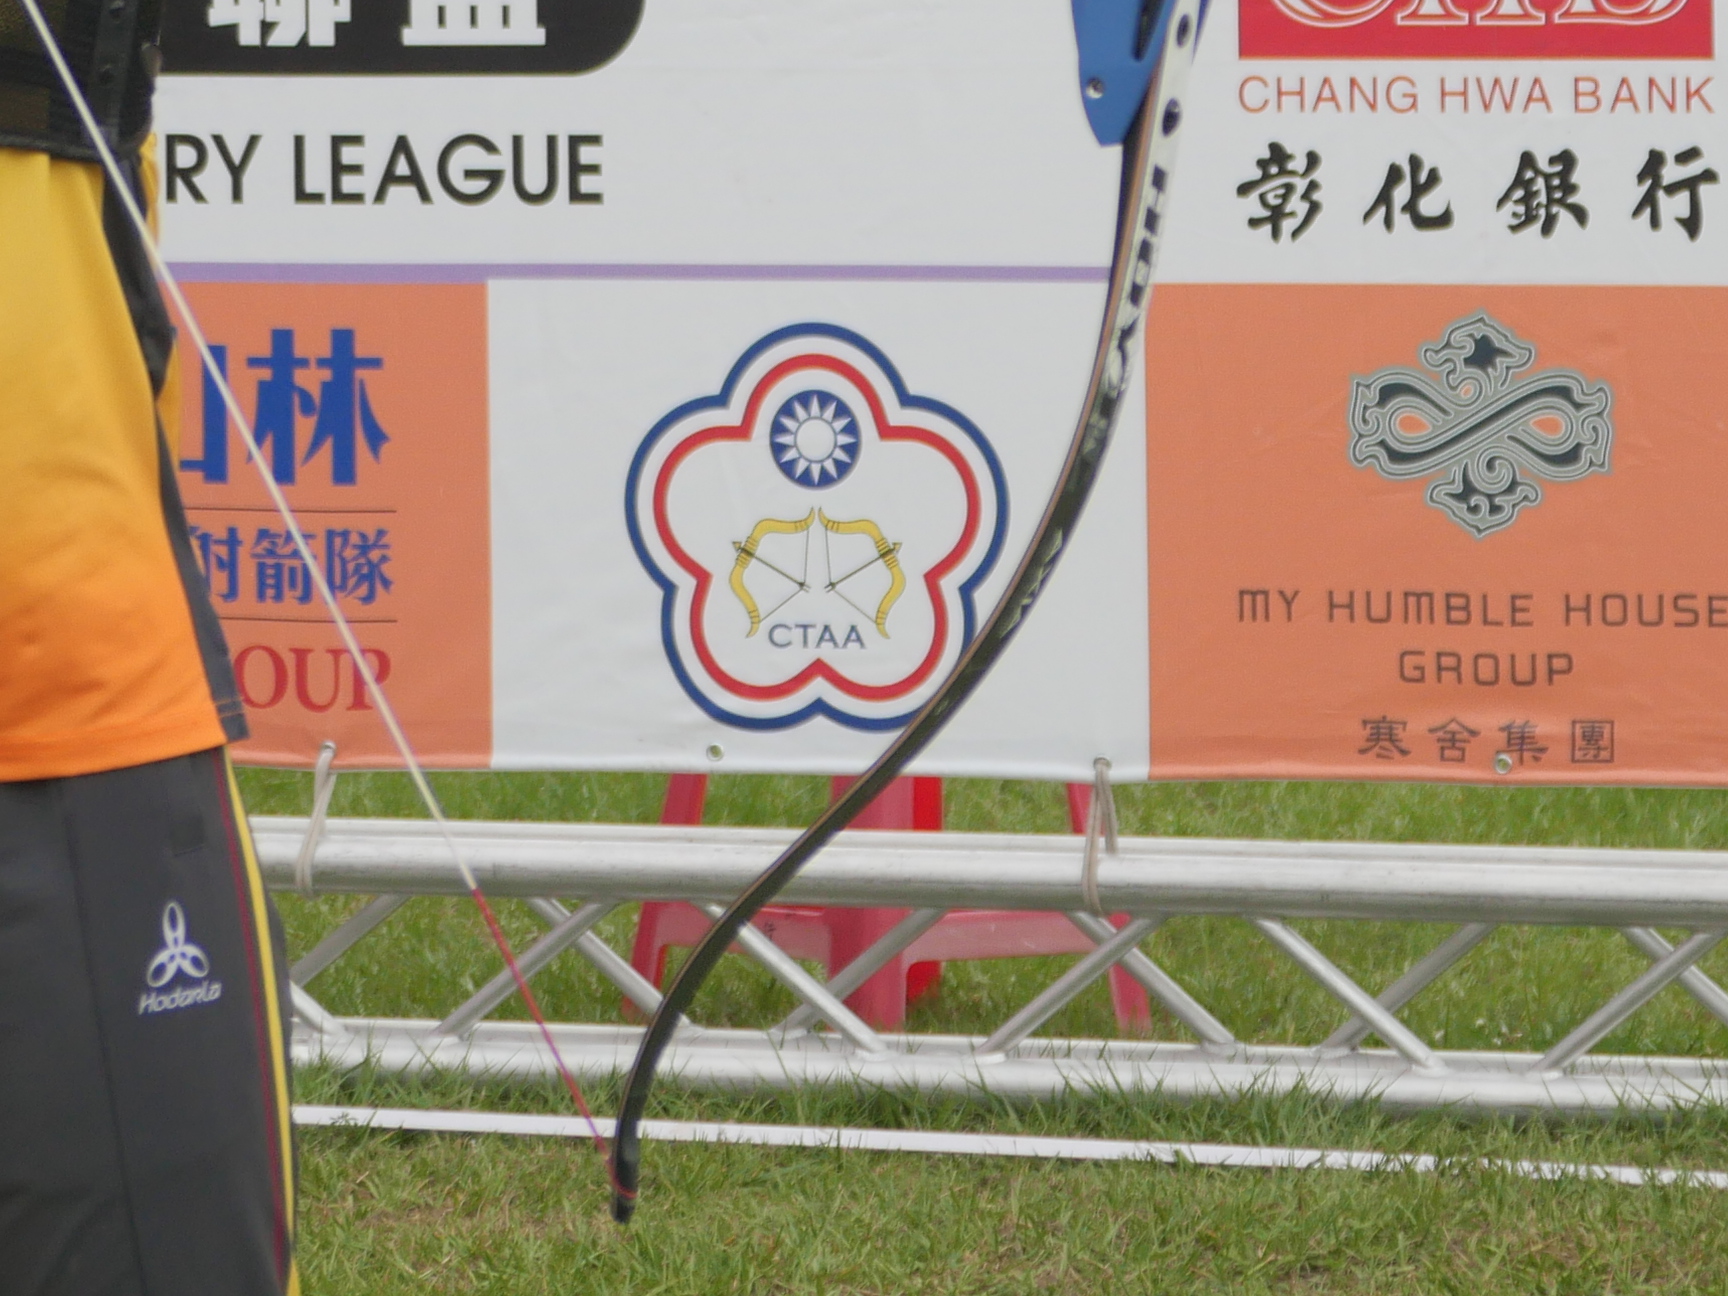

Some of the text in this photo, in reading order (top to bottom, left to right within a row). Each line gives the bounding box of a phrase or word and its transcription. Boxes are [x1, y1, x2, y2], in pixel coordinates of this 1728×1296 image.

[1238, 76, 1715, 114] CHANG HWA BANK
[293, 133, 604, 207] LEAGUE
[1236, 142, 1720, 243] 彰化銀行
[1238, 588, 1300, 623] MY
[1328, 589, 1534, 626] HUMBLE
[768, 623, 866, 650] CTAA
[1398, 650, 1573, 687] GROUP
[1357, 716, 1614, 763] 寒舍集團
